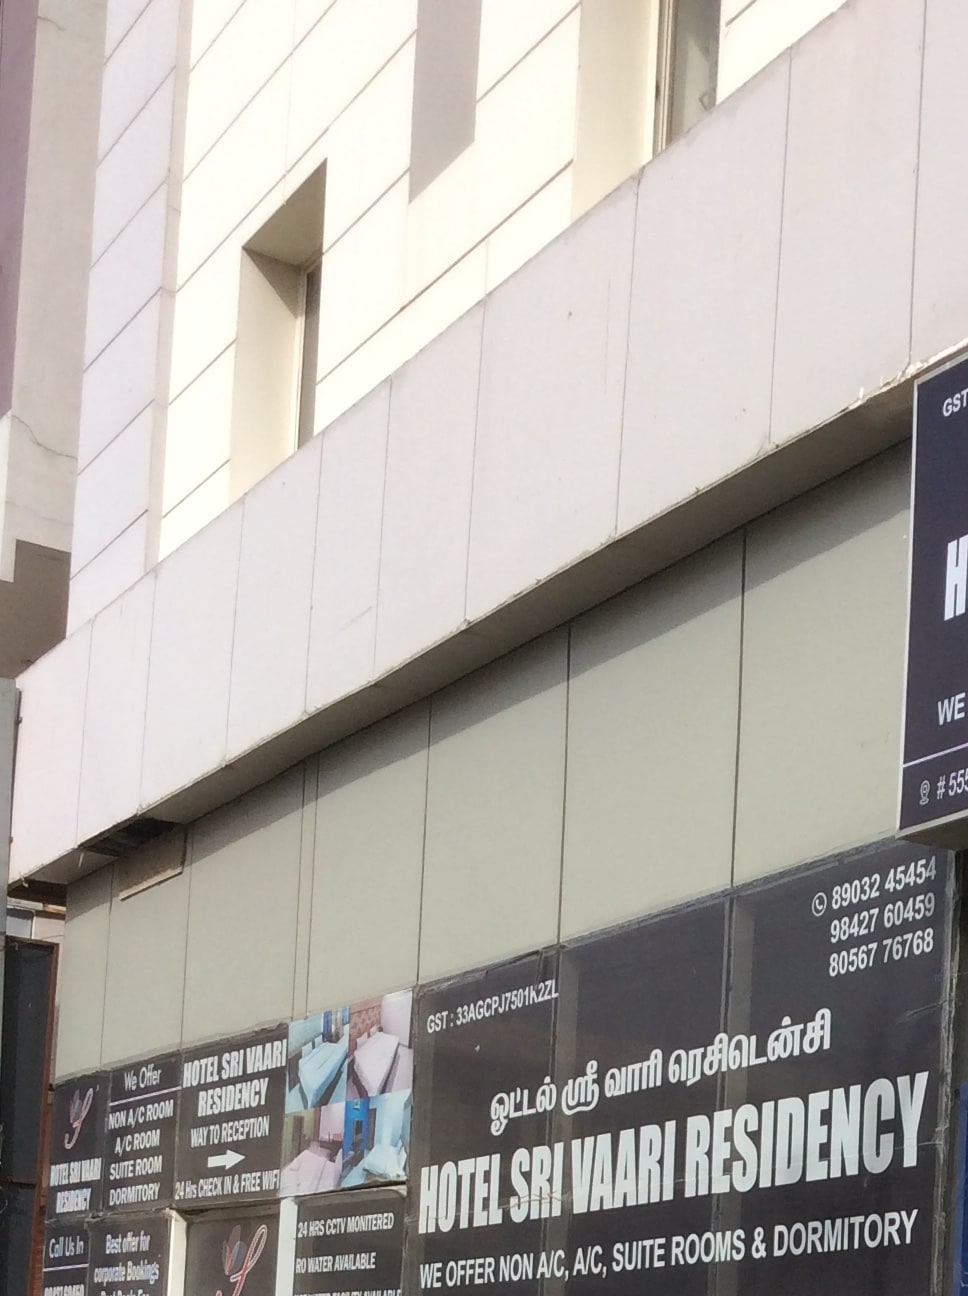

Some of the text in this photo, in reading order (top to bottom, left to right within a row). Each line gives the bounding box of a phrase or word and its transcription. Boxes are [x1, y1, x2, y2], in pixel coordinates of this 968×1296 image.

[938, 692, 966, 725] WE
[831, 856, 936, 909] 89032 45454
[830, 892, 935, 943] 98427 60459
[829, 927, 934, 976] 80567 76768
[427, 1011, 448, 1033] GST
[124, 1063, 161, 1091] We Offer
[183, 1039, 287, 1088] HOTEL SRI VAARI
[605, 1049, 663, 1097] வாரி
[198, 1077, 269, 1117] RESIDENCY
[108, 1099, 174, 1130] NON A/C ROOM
[115, 1129, 160, 1156] A/C ROOM
[191, 1115, 270, 1148] WAY TO RECEPTION
[109, 1155, 162, 1180] SUITE ROOM
[418, 1071, 929, 1234] HOTEL SRI VAARI RESIDENCY
[109, 1182, 160, 1206] DORMITORY
[174, 1181, 185, 1200] 24
[198, 1176, 222, 1198] CHECK
[223, 1175, 232, 1195] IN
[233, 1175, 239, 1194] &
[240, 1171, 260, 1193] FREE
[298, 1221, 308, 1238] 24
[308, 1219, 325, 1237] HRS
[326, 1217, 346, 1235] CCTV
[296, 1251, 377, 1274] RO WATER AVAILABLE
[420, 1209, 918, 1288] WE OFFER NON A/C, A/C, SUITE ROOMS & DORMITORY
